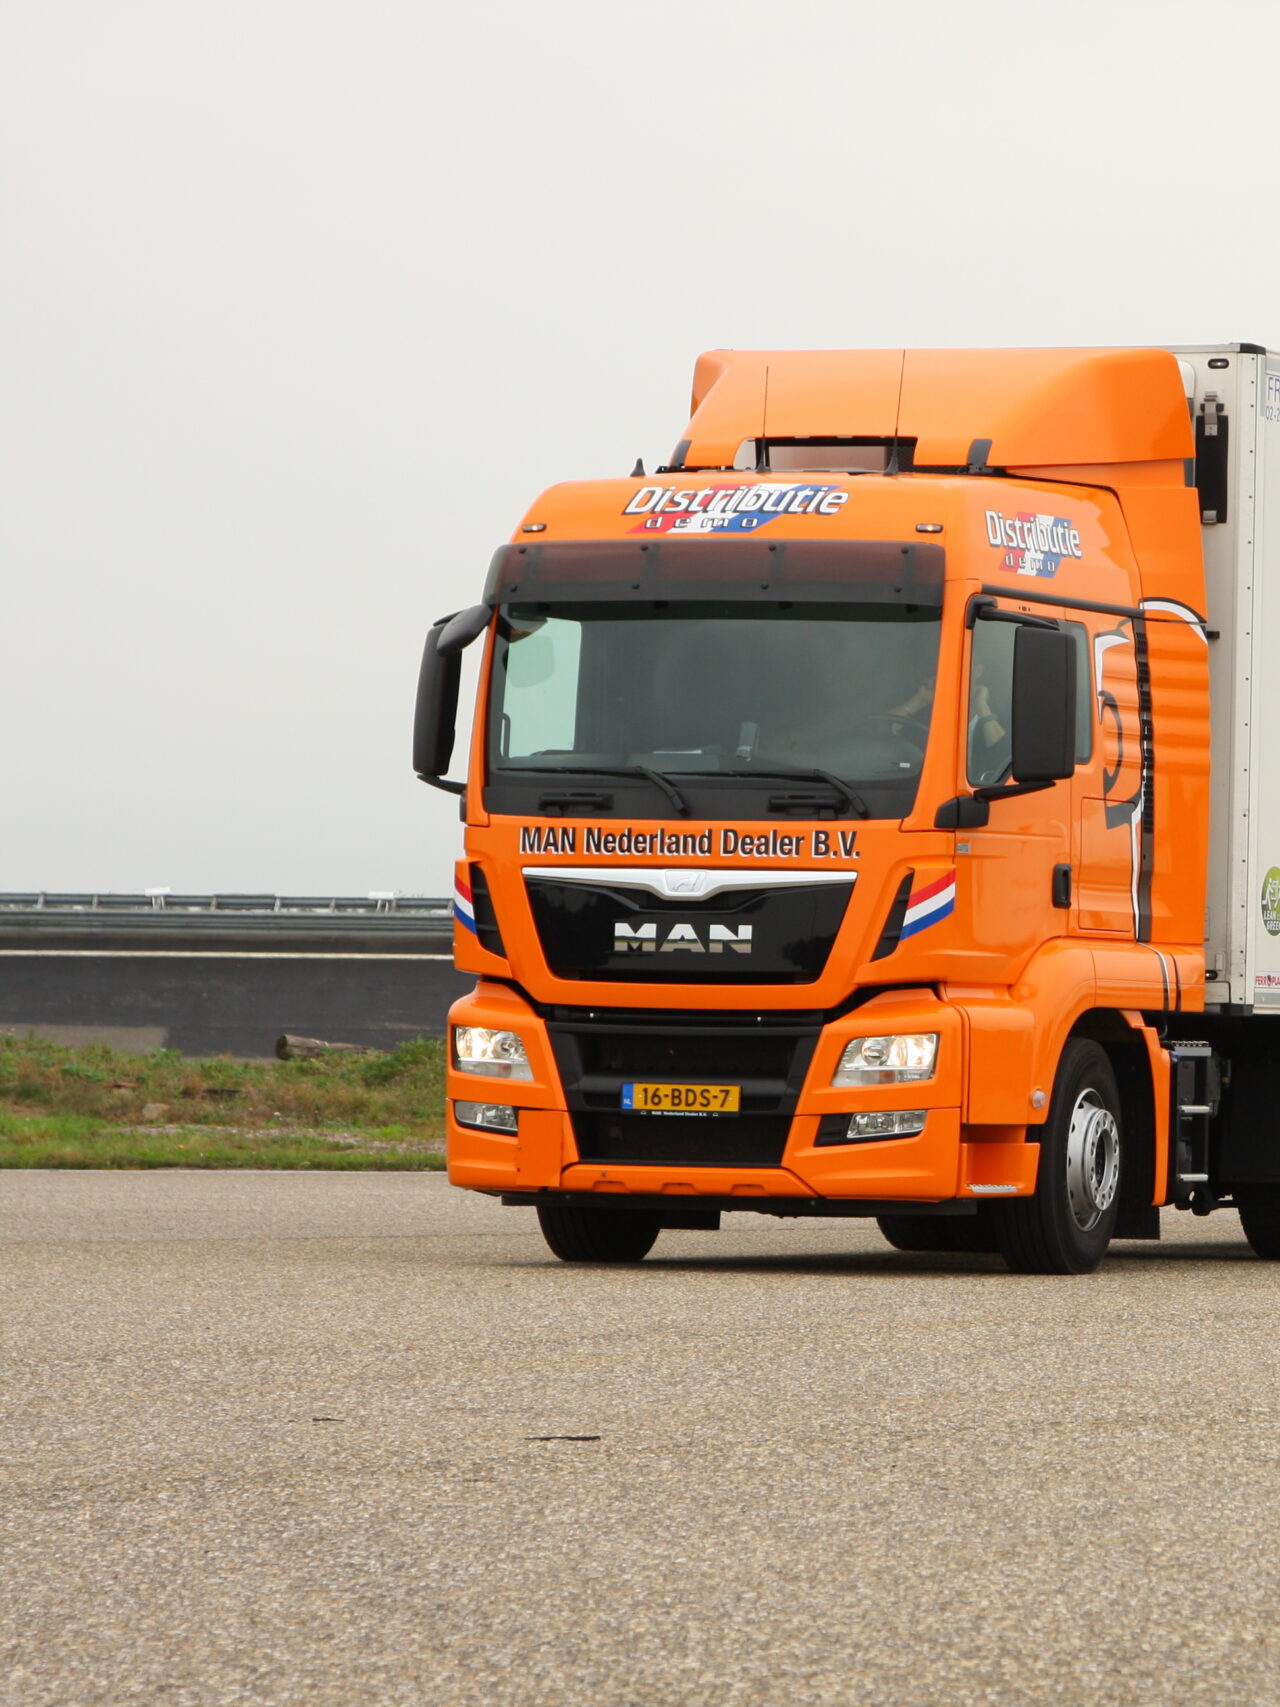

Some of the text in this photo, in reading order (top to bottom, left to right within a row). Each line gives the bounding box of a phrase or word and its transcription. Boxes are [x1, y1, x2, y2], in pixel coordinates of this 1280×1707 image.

[622, 484, 850, 515] Distributie
[644, 516, 759, 529] demo
[984, 509, 1083, 559] Distributie
[519, 826, 861, 859] MAN Nederland Dealer B.V.
[1263, 910, 1277, 921] LEAN
[614, 922, 752, 953] MAN
[642, 1087, 731, 1108] 16-BDS-7
